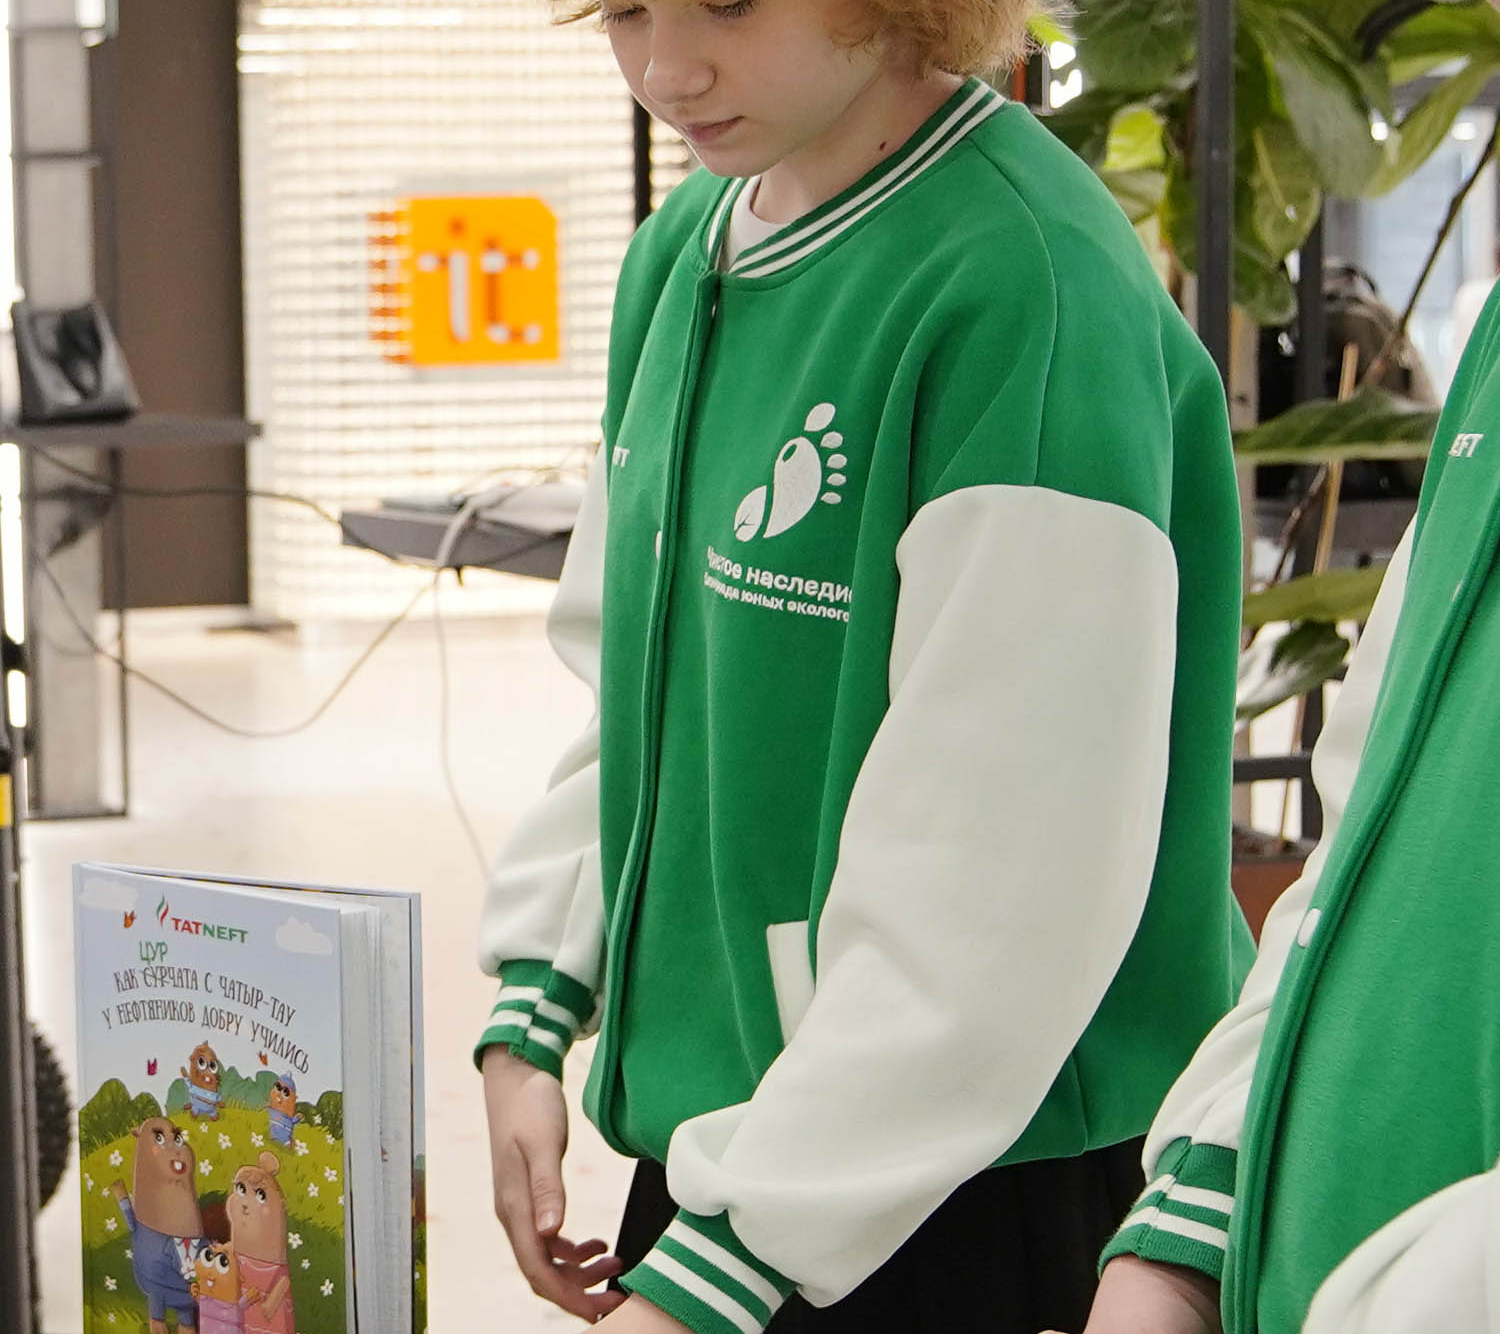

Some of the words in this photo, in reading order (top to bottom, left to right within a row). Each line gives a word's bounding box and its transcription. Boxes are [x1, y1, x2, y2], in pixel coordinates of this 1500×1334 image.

[138, 940, 169, 964] ЦУР
[171, 916, 249, 944] TATNEFT
[113, 967, 139, 993] КАК
[204, 971, 214, 994] С
[218, 974, 297, 1028] ЧАТЫР-ТАУ
[101, 1008, 112, 1030] У
[116, 998, 196, 1026] НЕФТЯНИКОВ
[201, 1005, 243, 1036] ДОБРУ
[250, 1020, 310, 1075] УЧИЛИСЬ
